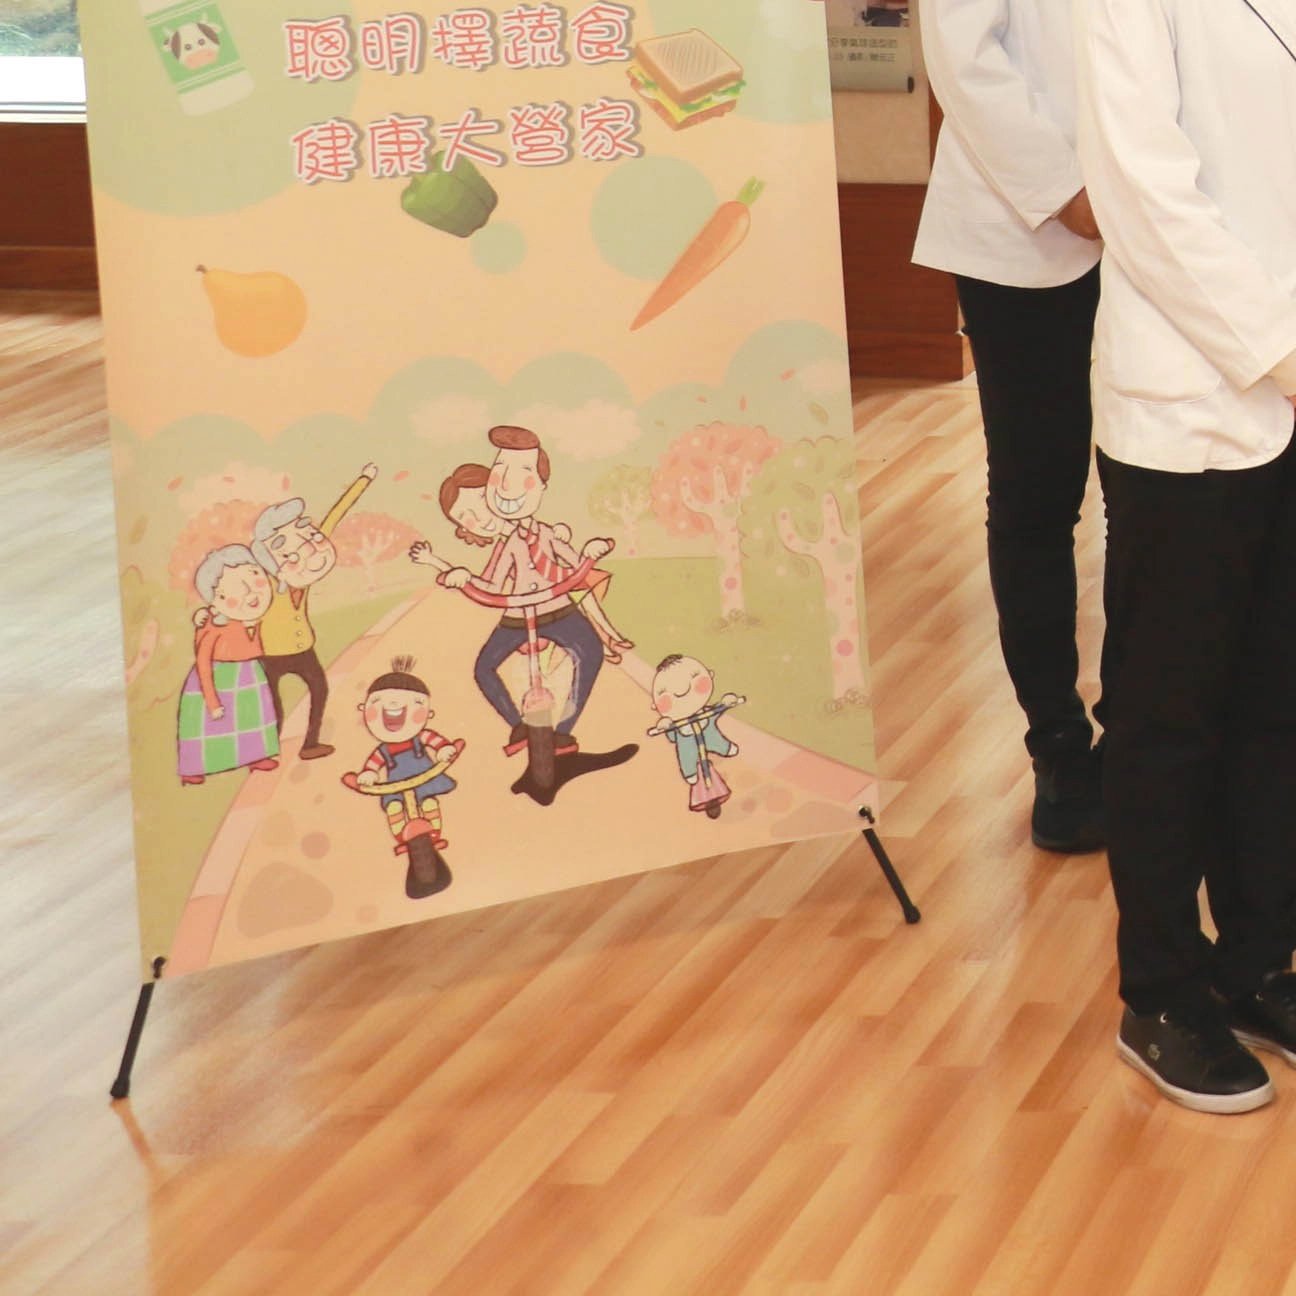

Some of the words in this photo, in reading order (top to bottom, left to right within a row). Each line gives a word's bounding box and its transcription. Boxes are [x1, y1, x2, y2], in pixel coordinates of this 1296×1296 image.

[285, 1, 631, 82] 聰明擇蔬食
[293, 100, 640, 183] 健康大營家
